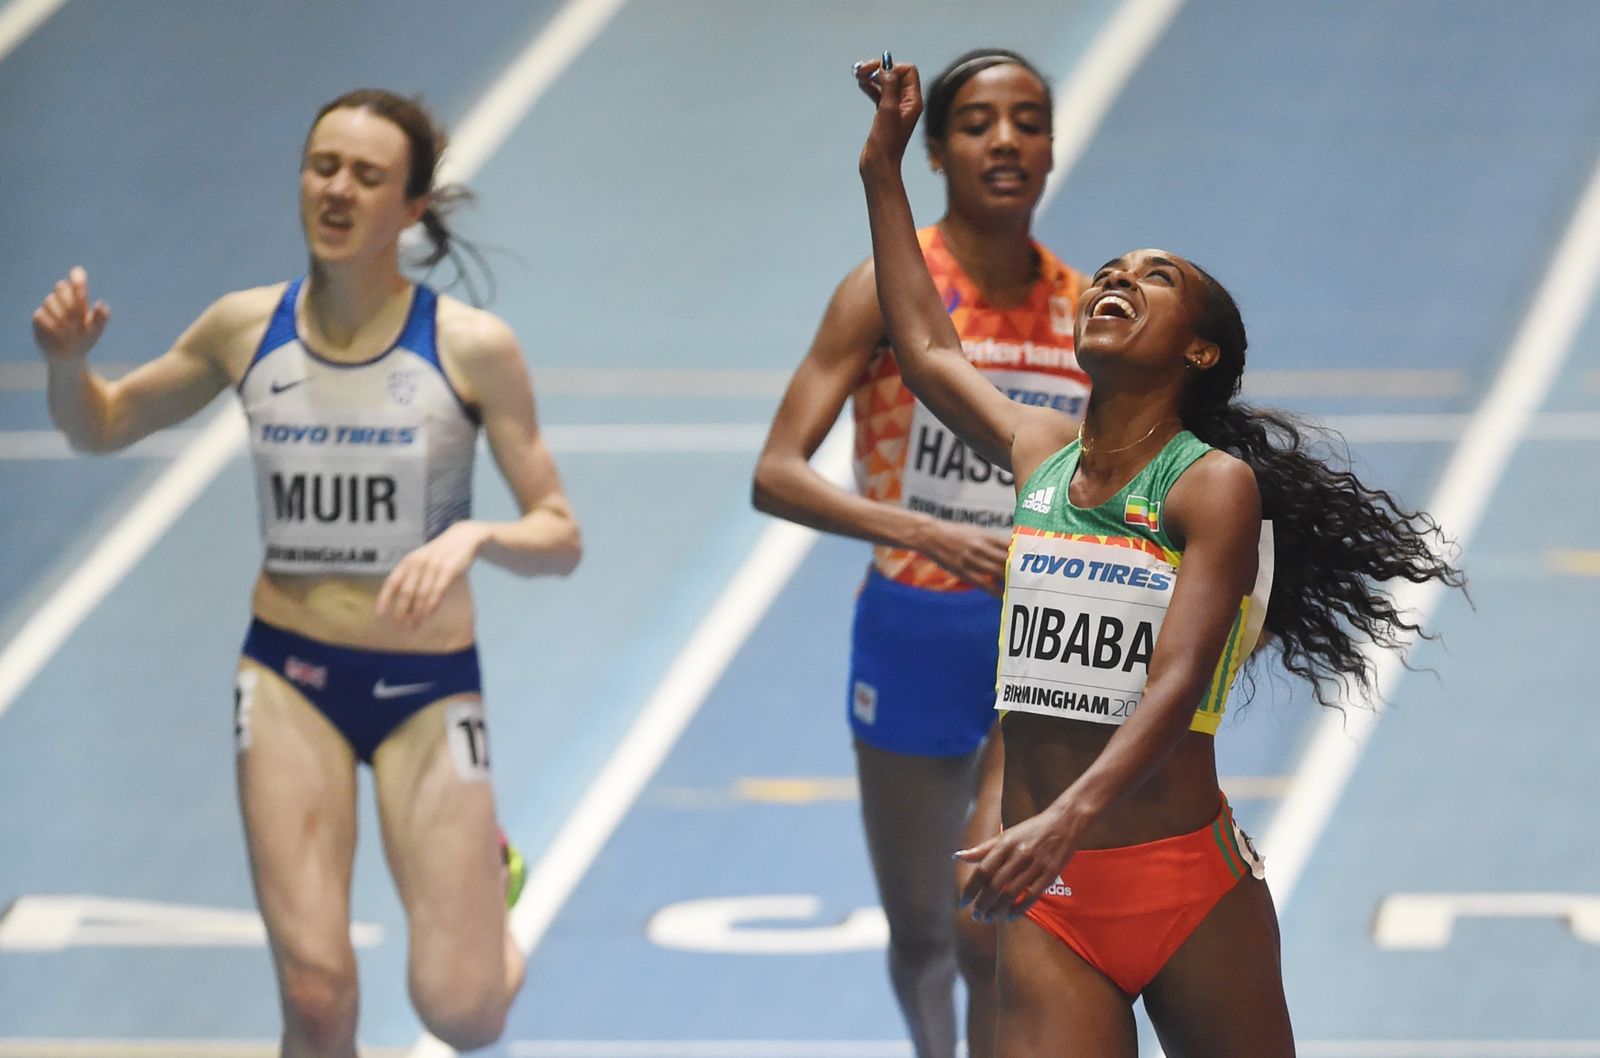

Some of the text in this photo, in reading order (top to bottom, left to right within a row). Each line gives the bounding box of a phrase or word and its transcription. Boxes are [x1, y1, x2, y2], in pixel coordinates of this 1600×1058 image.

[261, 424, 417, 444] TOYO TIRES
[271, 473, 397, 523] MUIR
[1020, 554, 1171, 591] TOYO TIRES
[1008, 604, 1153, 675] DIBABA
[1003, 684, 1109, 715] BIRMINGHAM
